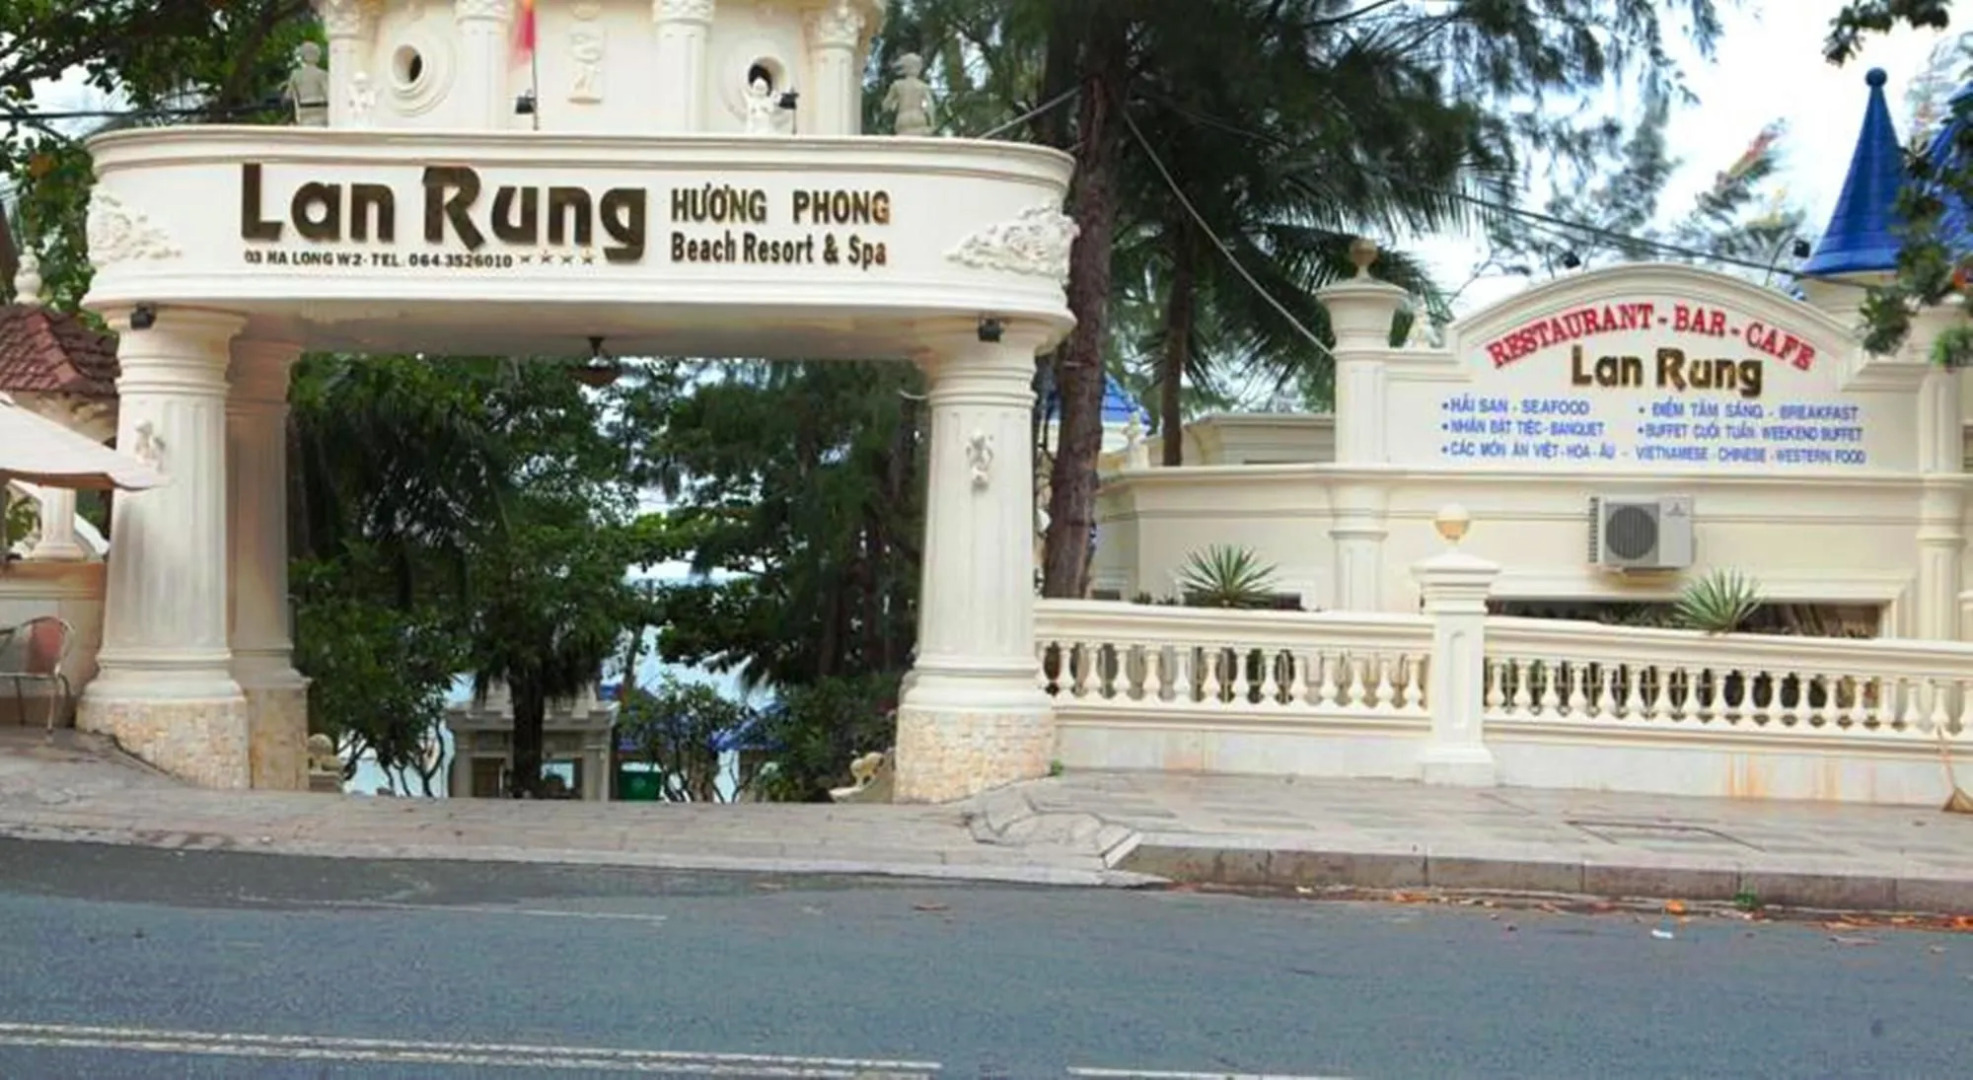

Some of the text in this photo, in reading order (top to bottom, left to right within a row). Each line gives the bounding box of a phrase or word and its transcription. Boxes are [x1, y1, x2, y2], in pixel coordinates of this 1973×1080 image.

[241, 163, 647, 264] Lan Rung
[671, 182, 890, 225] HƯƠNG PHONG
[244, 251, 262, 264] 03
[292, 252, 333, 266] LONG
[671, 230, 887, 270] Beach Resort & Spa
[1485, 303, 1654, 368] RESTAURANT
[1673, 306, 1727, 337] BAR
[1745, 321, 1816, 371] CAFE
[1571, 344, 1763, 398] Lan Rung
[1521, 399, 1590, 415] SEAFOOD
[1780, 405, 1859, 421] BREAKFAST
[1645, 423, 1688, 439] BUFFET
[1762, 426, 1818, 441] WEEKEND
[1821, 426, 1863, 441] BUFFET
[1835, 448, 1867, 464] FOOD
